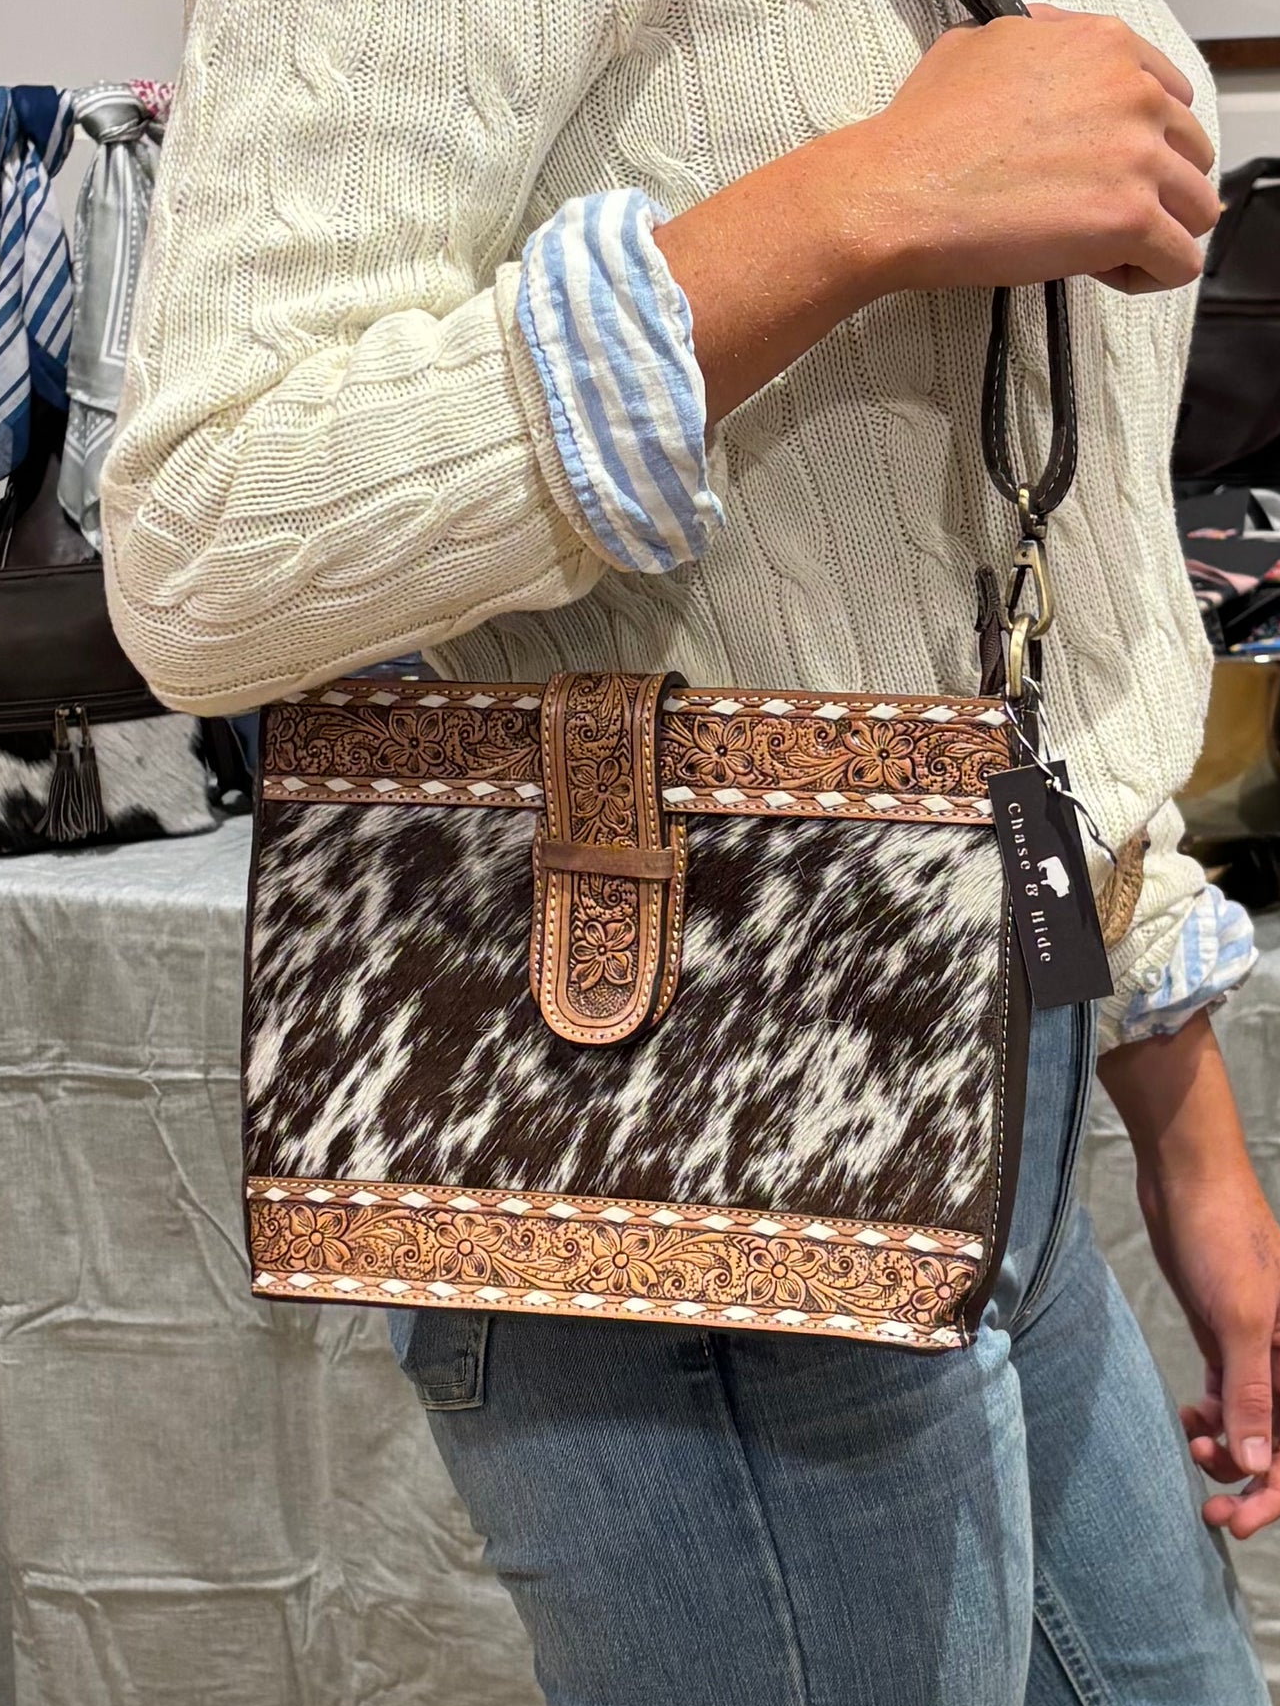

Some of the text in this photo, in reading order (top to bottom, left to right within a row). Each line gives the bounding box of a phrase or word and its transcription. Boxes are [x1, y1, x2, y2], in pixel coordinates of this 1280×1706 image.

[1008, 802, 1052, 962] Chase & Hide
